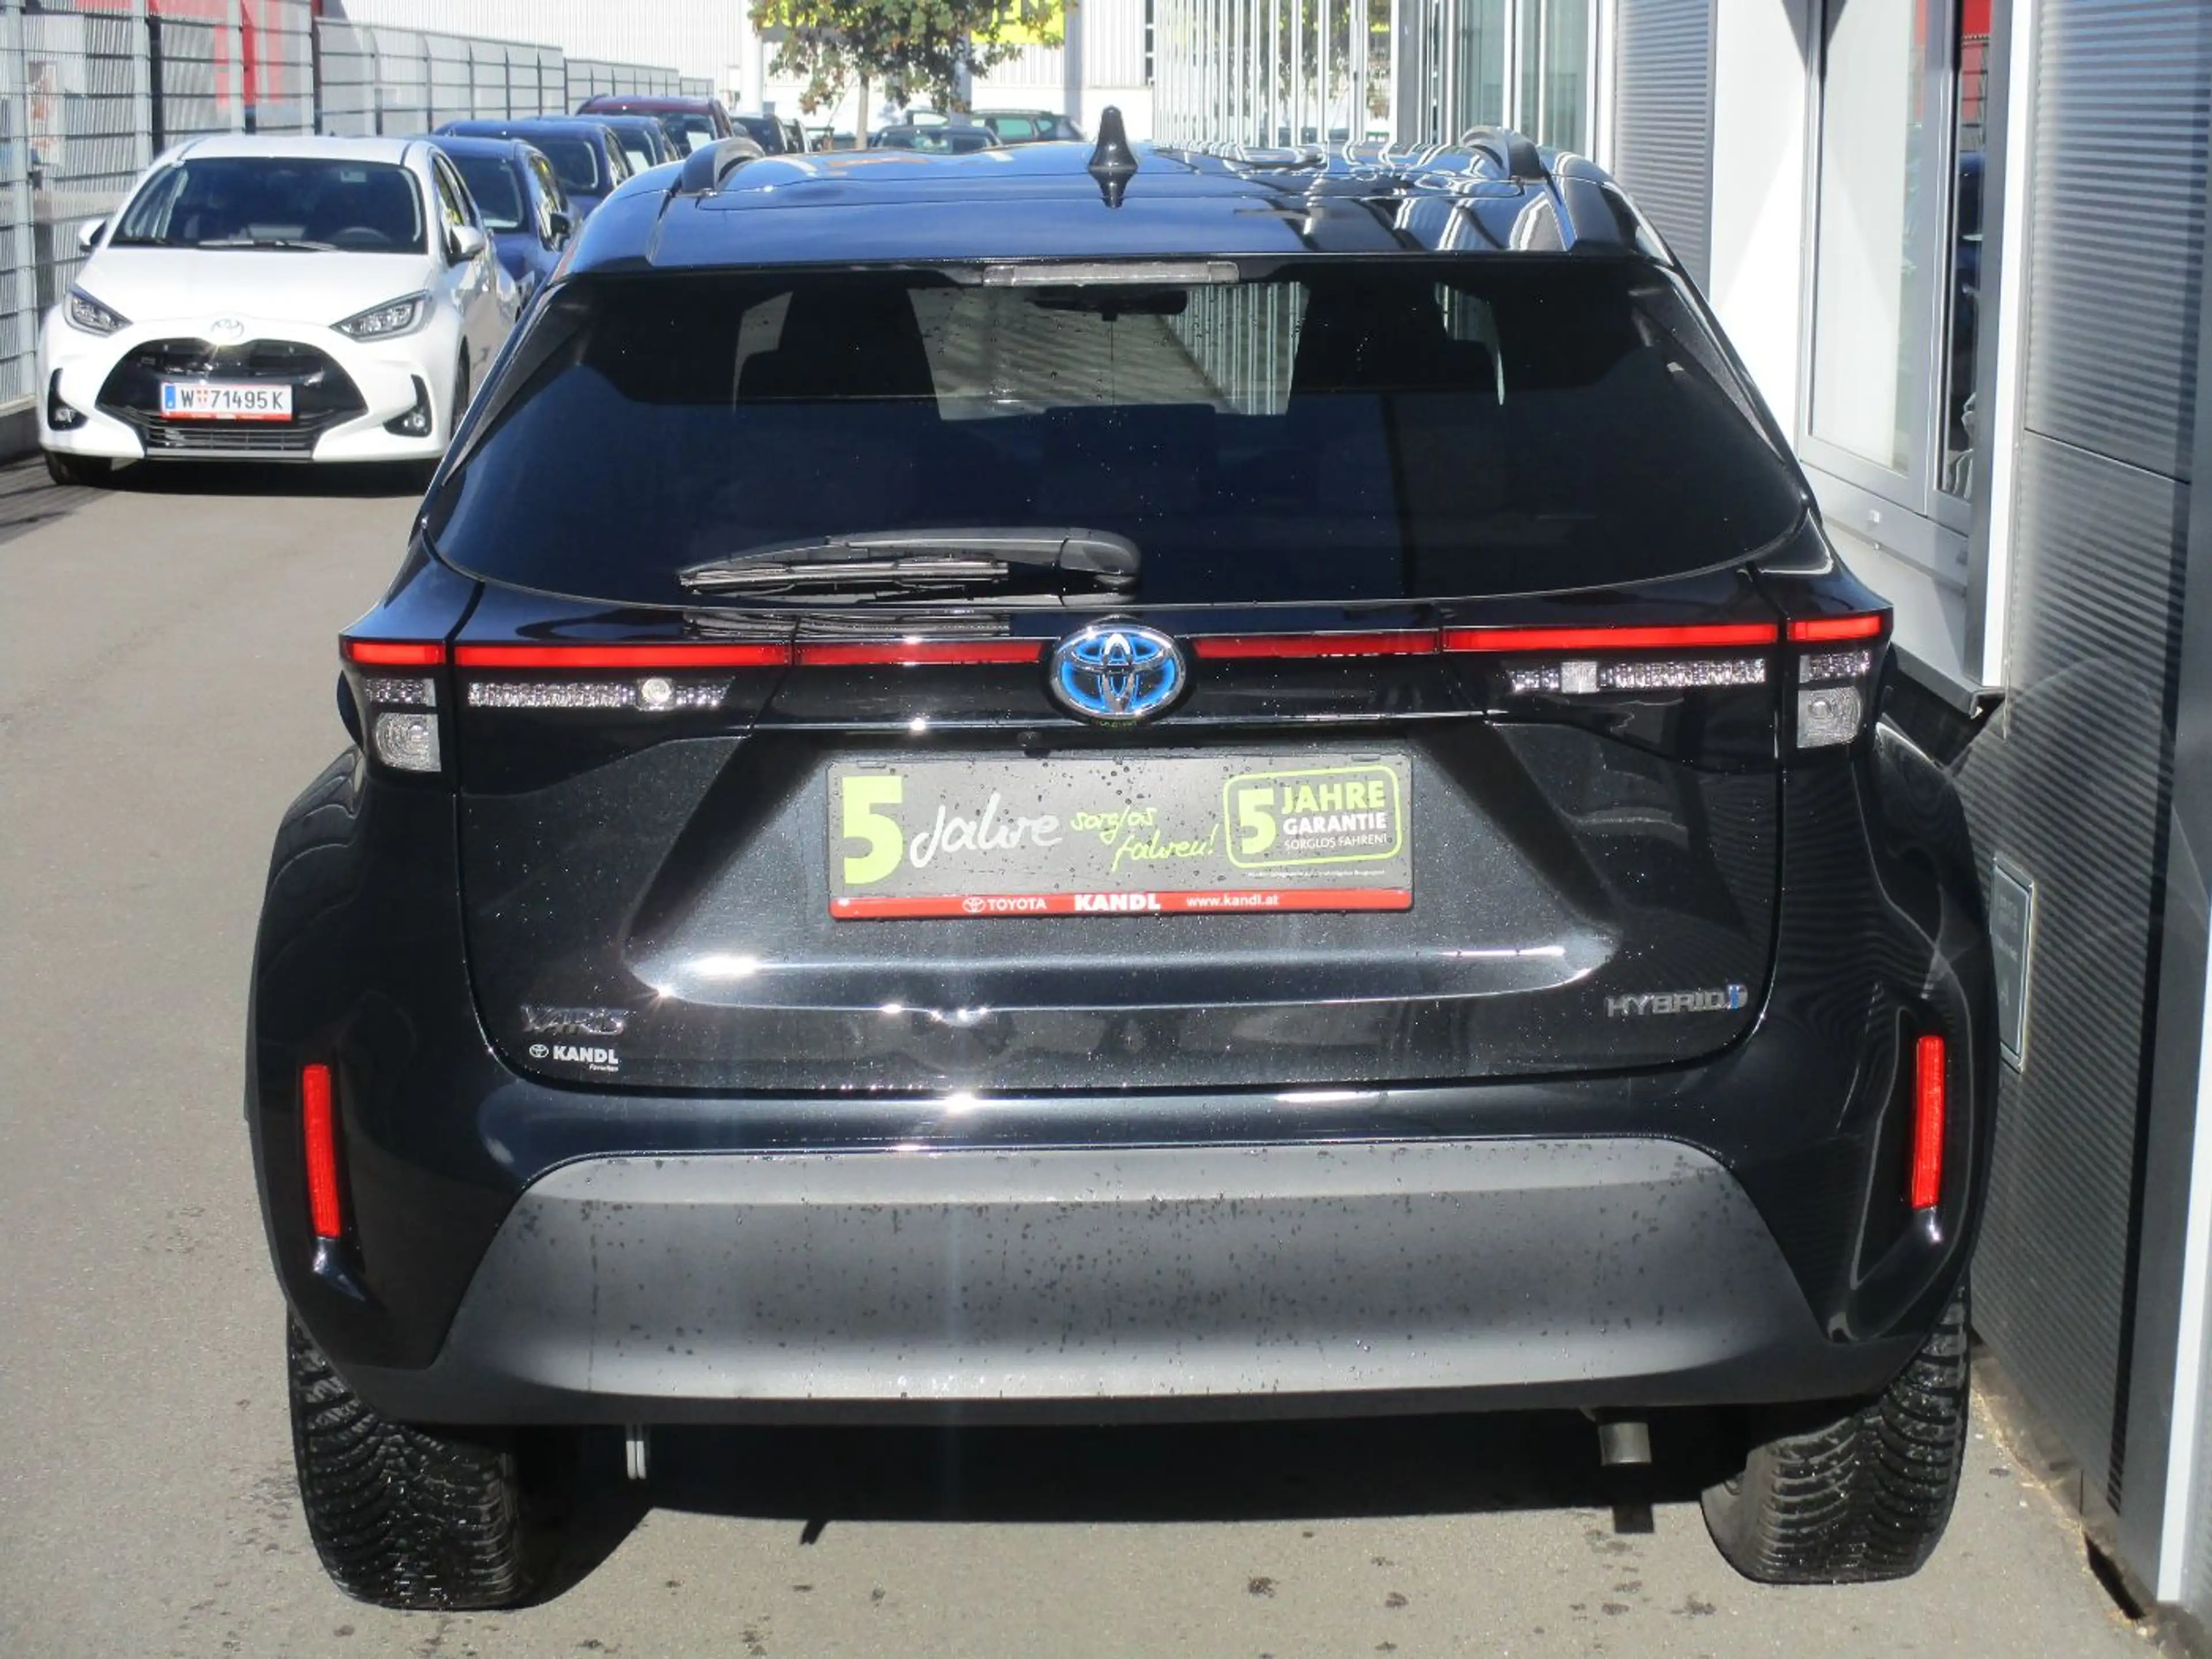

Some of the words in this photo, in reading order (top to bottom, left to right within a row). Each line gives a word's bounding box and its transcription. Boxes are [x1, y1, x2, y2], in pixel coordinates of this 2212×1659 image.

[181, 390, 194, 408] W
[1281, 780, 1385, 815] JAHRE
[842, 775, 903, 884] 5
[910, 791, 1063, 868] Jahre
[1070, 806, 1158, 844] sorglos
[1238, 788, 1276, 854] 5
[1283, 812, 1388, 836] GARANTIE
[1284, 837, 1336, 851] SORGLOS
[987, 897, 1048, 911] TOYOTA
[1074, 892, 1161, 912] KANDL
[1185, 893, 1279, 908] www.kandl.at
[1605, 991, 1726, 1018] HYBRID
[552, 1045, 619, 1065] KANDL
